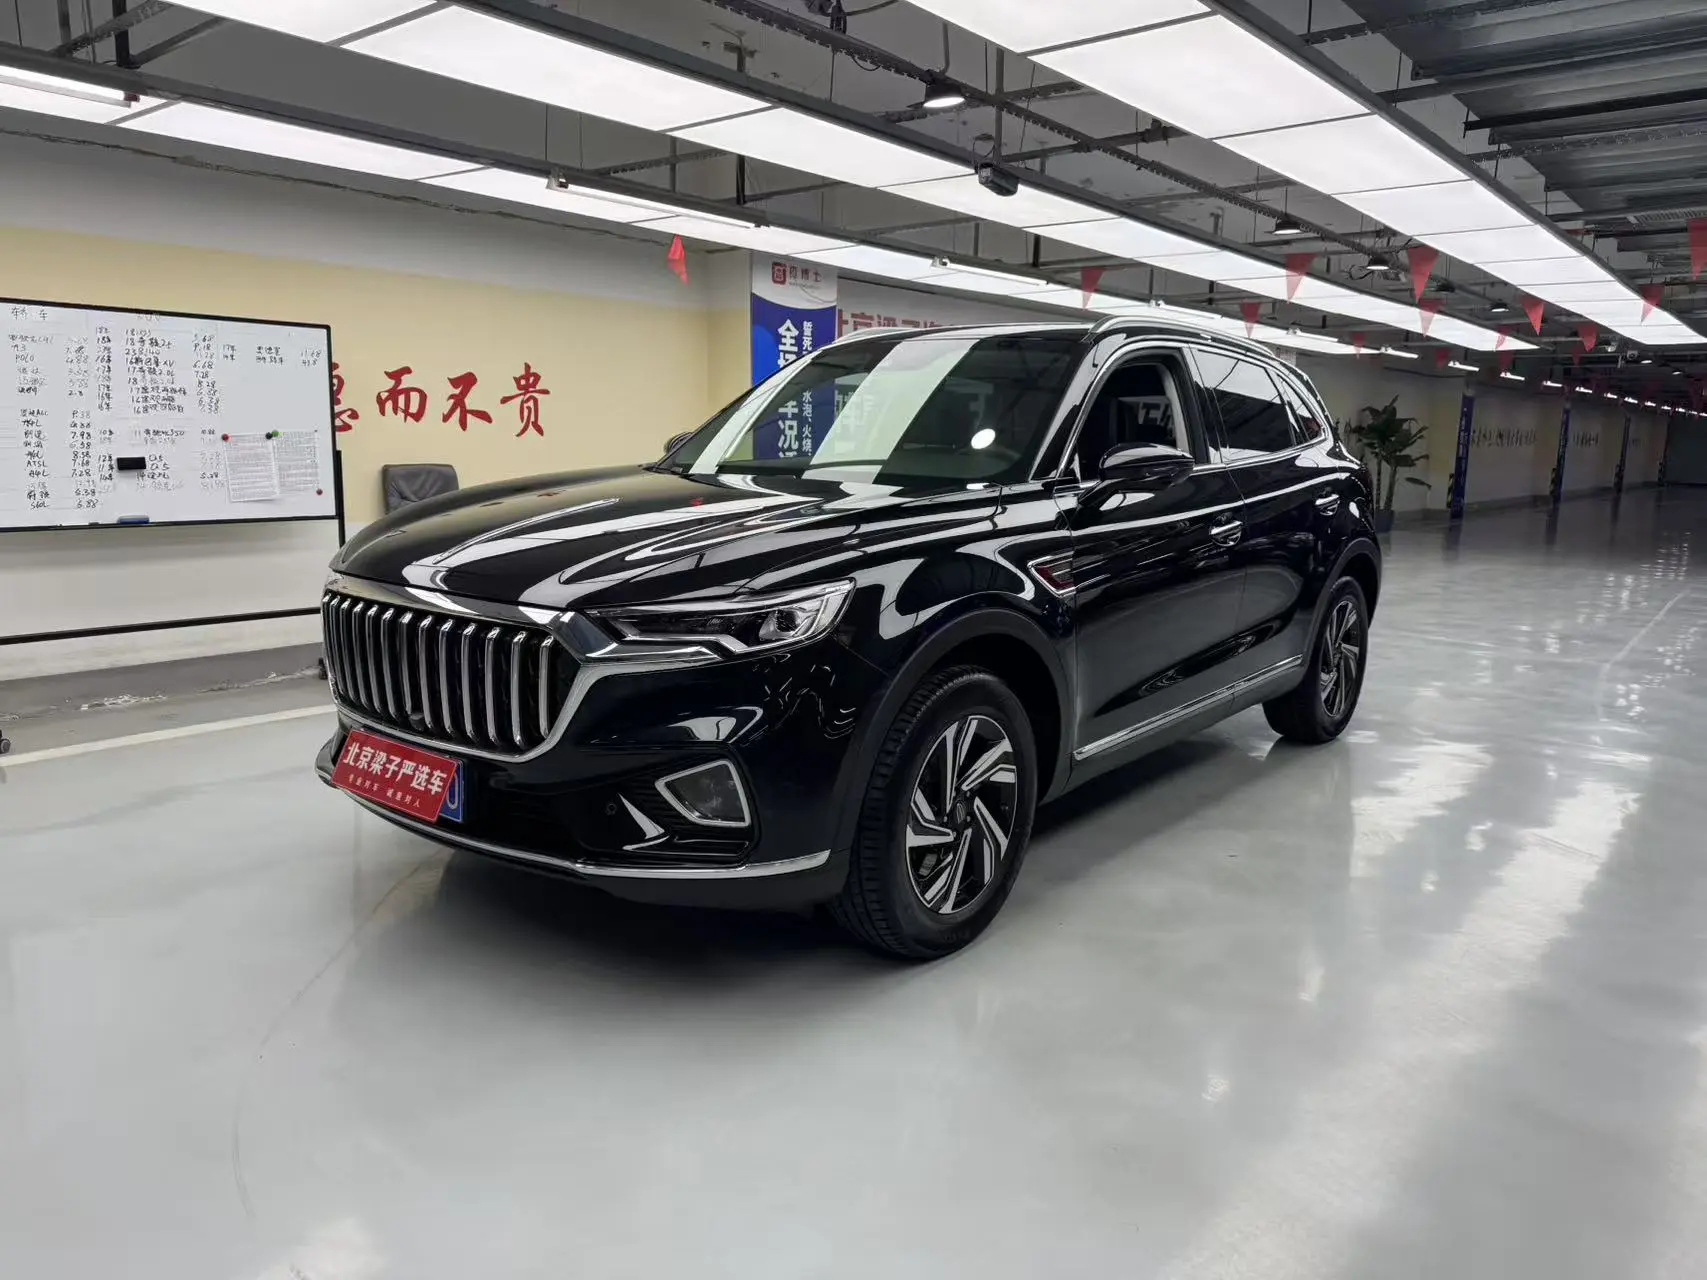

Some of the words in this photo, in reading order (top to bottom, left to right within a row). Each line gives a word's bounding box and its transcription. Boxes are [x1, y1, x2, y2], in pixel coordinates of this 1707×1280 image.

[342, 741, 448, 795] 北京梁子严选车
